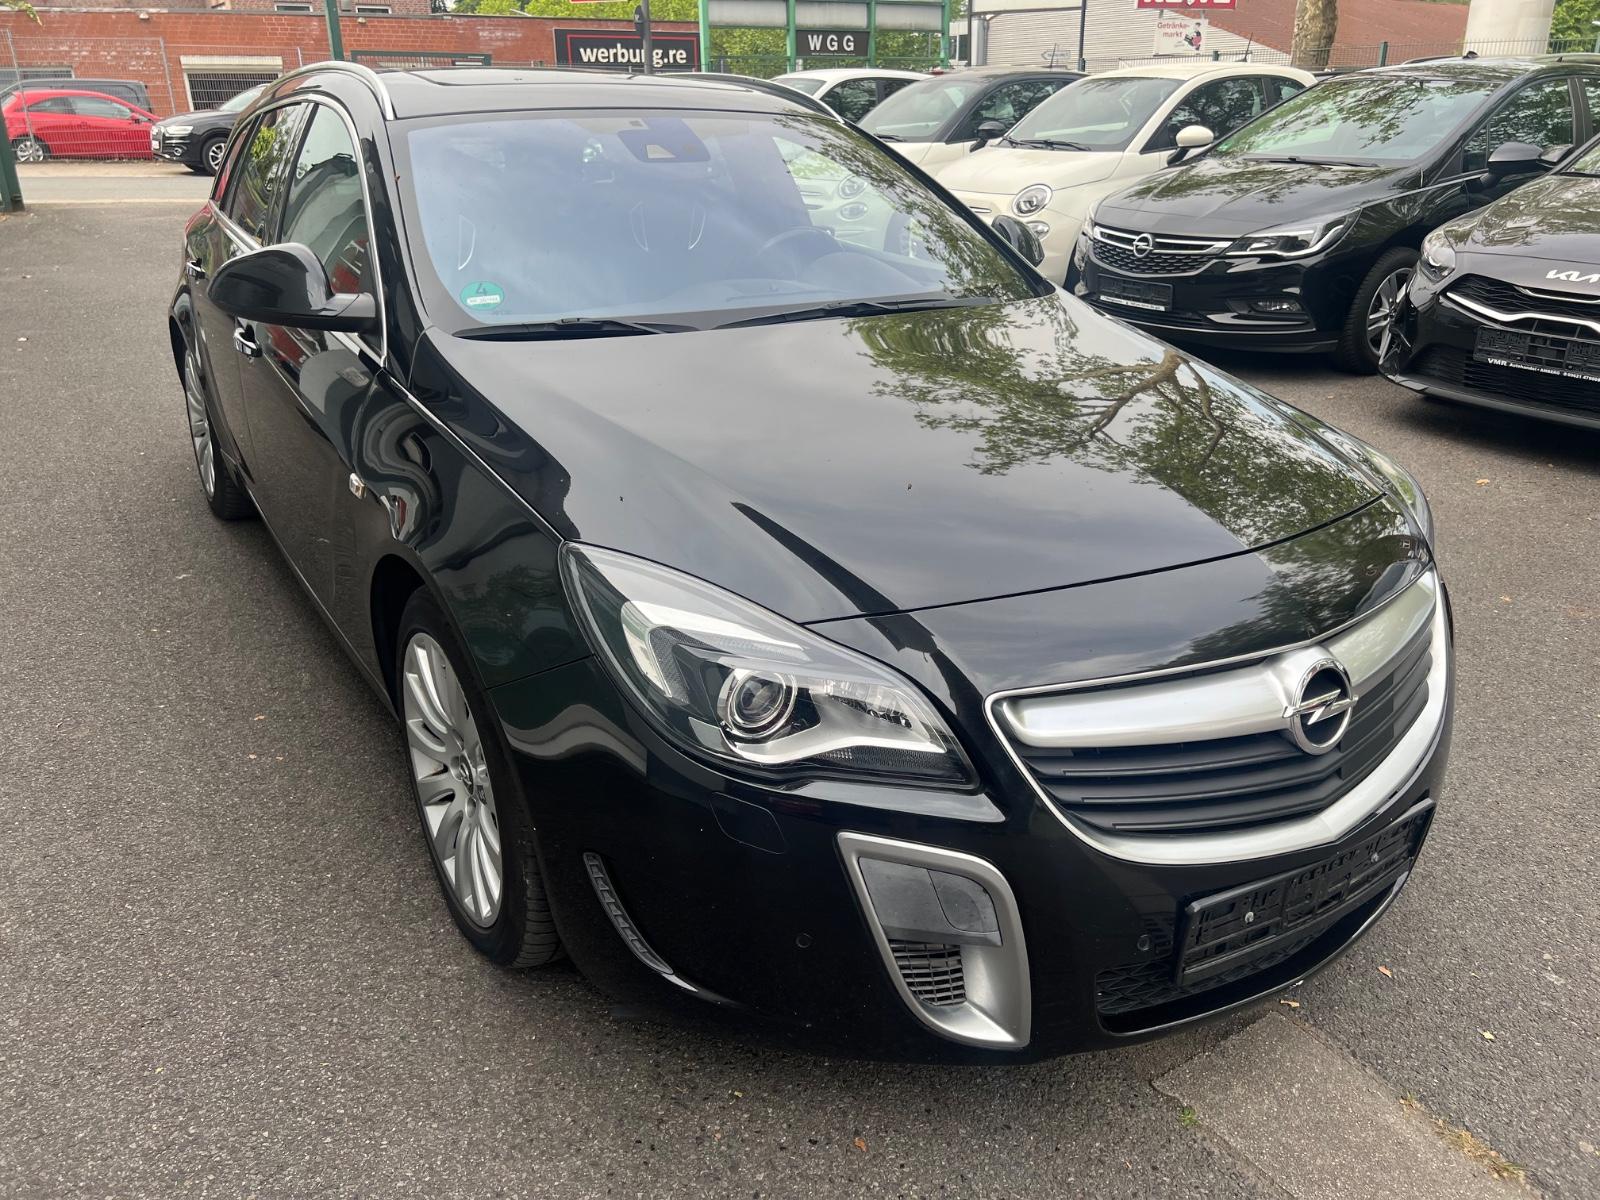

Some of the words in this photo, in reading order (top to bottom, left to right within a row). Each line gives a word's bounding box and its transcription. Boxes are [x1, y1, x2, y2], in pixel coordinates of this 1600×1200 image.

[579, 43, 686, 67] werbug.re
[476, 283, 487, 296] 4
[1488, 358, 1507, 366] VMR
